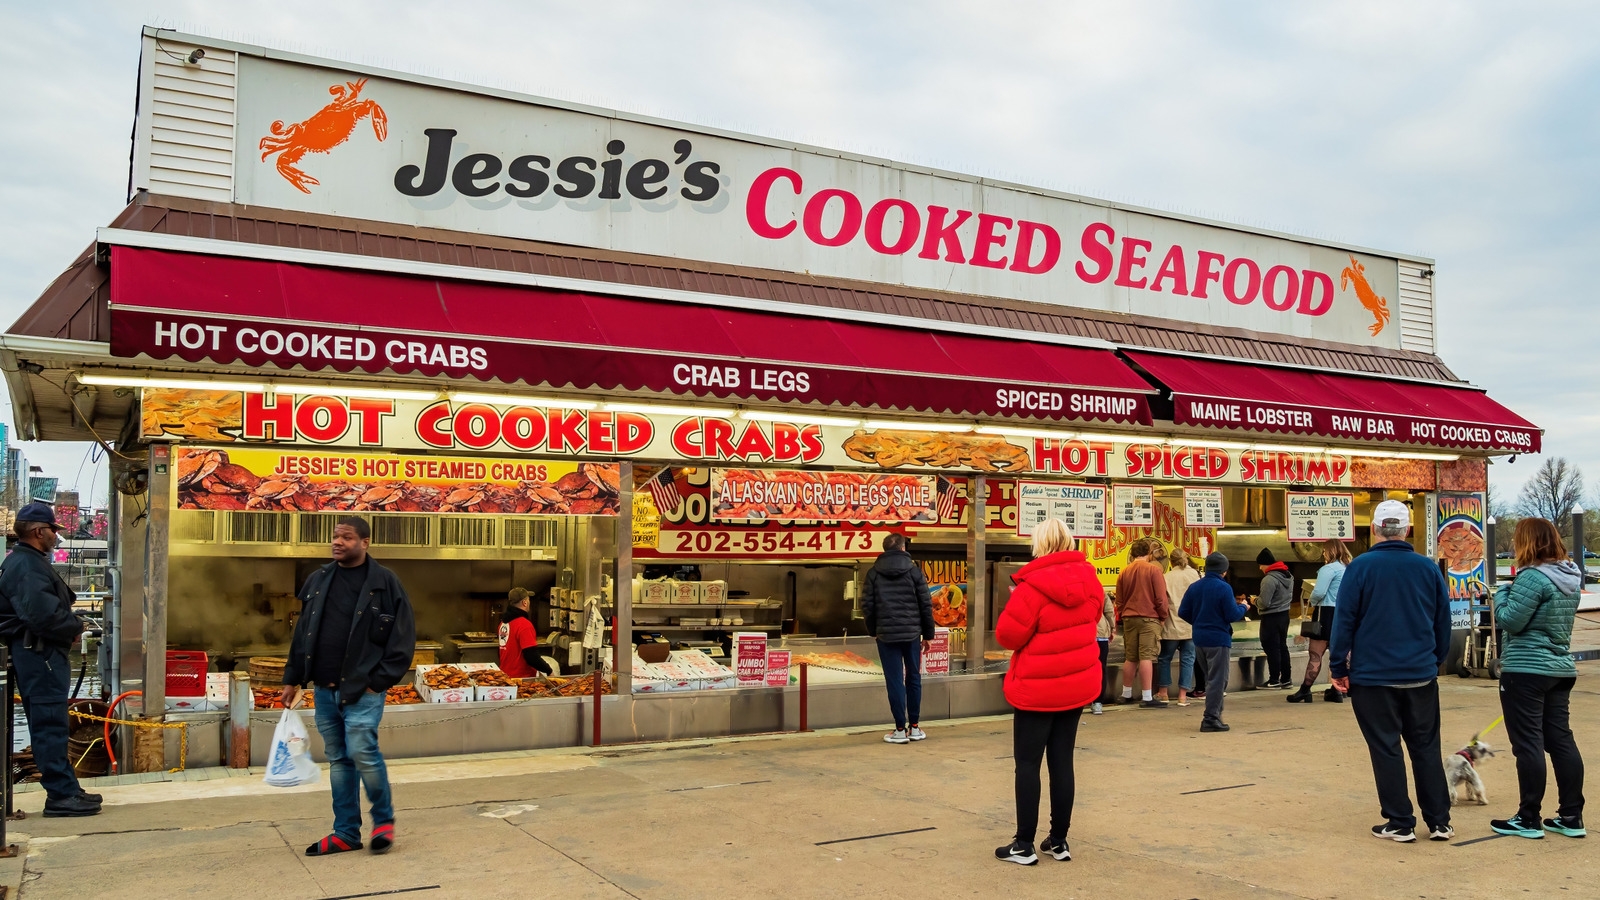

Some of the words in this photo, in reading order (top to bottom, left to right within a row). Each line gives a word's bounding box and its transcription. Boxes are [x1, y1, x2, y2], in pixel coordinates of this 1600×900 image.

[394, 128, 721, 202] Jessie's
[746, 167, 1062, 275] COOKED
[1074, 222, 1335, 316] SEAFOOD
[154, 321, 227, 350] HOT
[235, 328, 376, 361] COOKED
[384, 340, 489, 370] CRABS
[673, 363, 741, 387] CRAB
[750, 368, 811, 393] LEGS
[995, 388, 1063, 411] SPICED
[1069, 393, 1137, 416] SHRIMP
[1190, 402, 1241, 422] MAINE
[1246, 406, 1313, 428] LOBSTER
[242, 391, 396, 446] HOT
[415, 402, 655, 456] COOKED
[671, 415, 824, 463] CRABS
[1331, 415, 1362, 432] RAW
[1367, 418, 1395, 435] BAR
[1411, 421, 1436, 438] HOT
[1440, 426, 1491, 443] COOKED
[1494, 430, 1531, 447] CRABS
[275, 456, 358, 476] JESSIE'S
[362, 459, 400, 477] HOT
[404, 460, 487, 479] STEAMED
[491, 464, 548, 481] CRABS
[1033, 437, 1116, 476] HOT
[1125, 441, 1231, 479] SPICED
[1240, 448, 1348, 485] SHRIMP
[719, 480, 798, 505] ALASKAN
[802, 482, 846, 506] CRAB
[850, 484, 889, 508] LEGS
[892, 485, 930, 507] SALE
[1061, 487, 1104, 499] SHRIMP
[1308, 496, 1329, 507] RAW
[1331, 496, 1349, 507] BAR
[1439, 497, 1482, 524] STEAMED
[676, 530, 873, 552] 202-554-4173
[1104, 567, 1120, 575] THE
[1448, 569, 1484, 599] RABS
[738, 658, 765, 668] JUMBO
[926, 652, 948, 661] JUMBO
